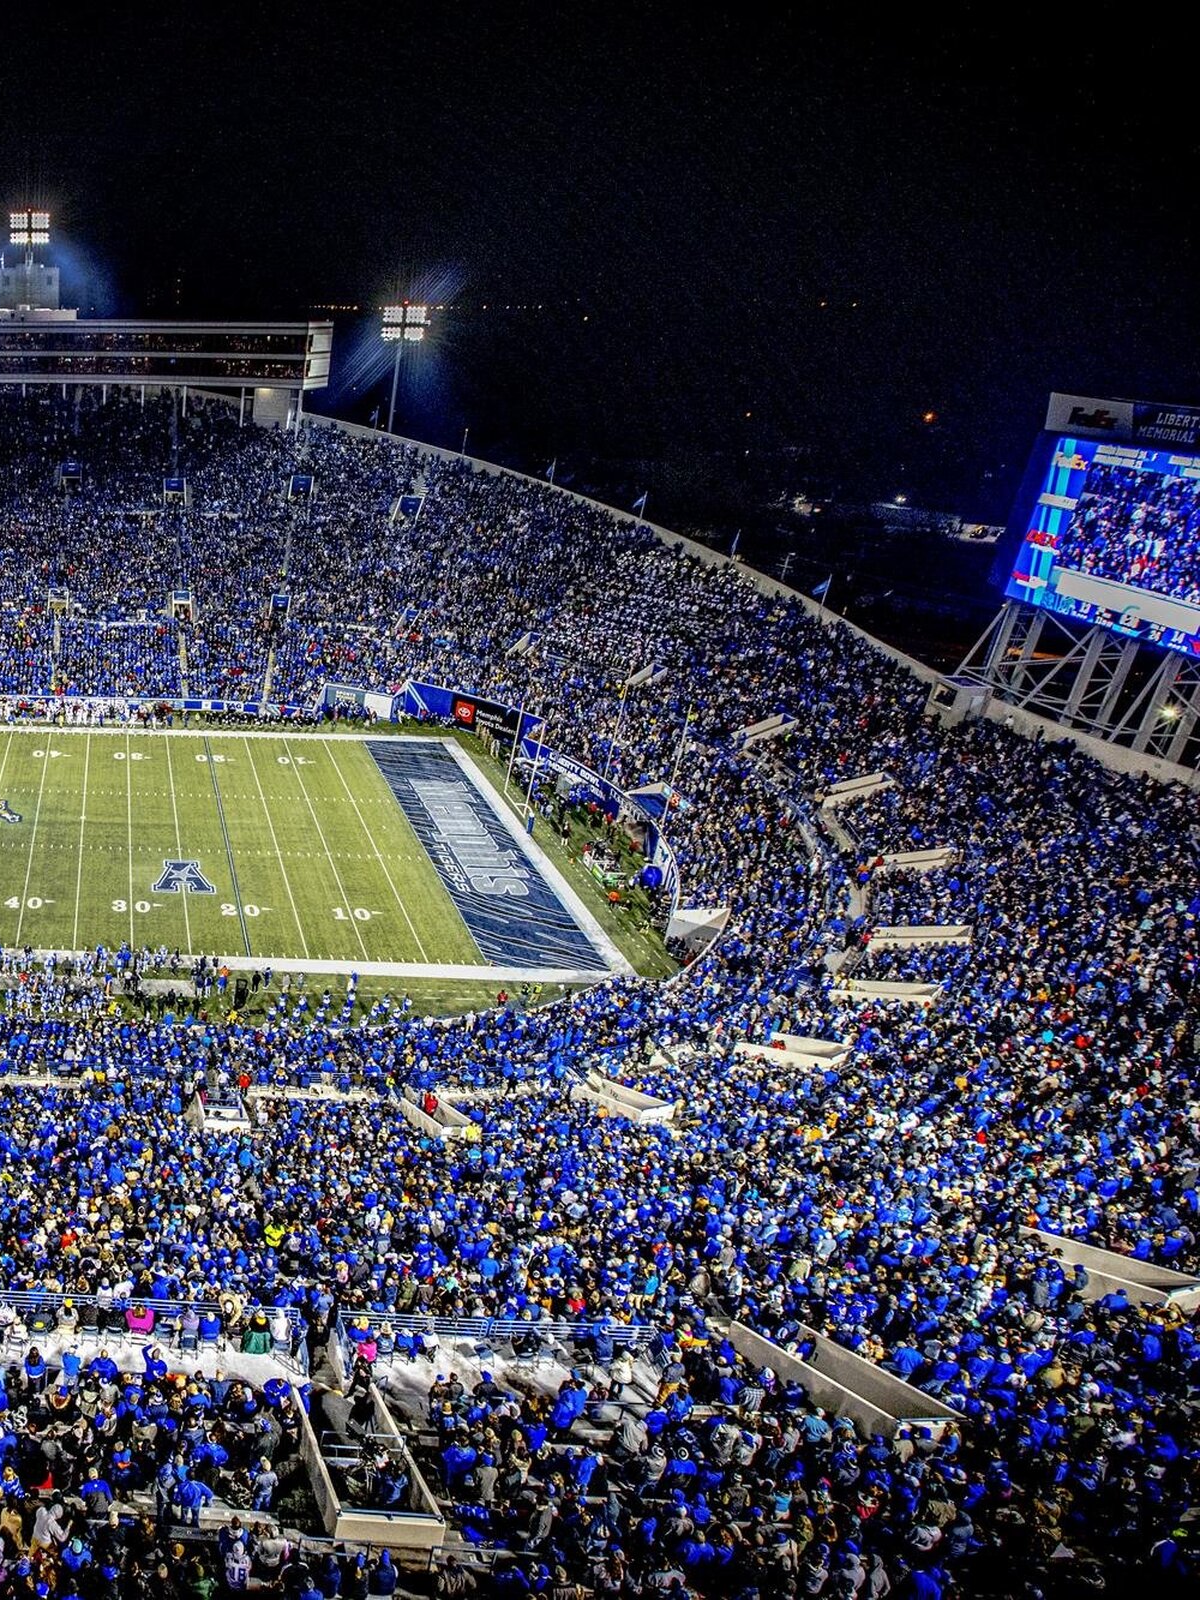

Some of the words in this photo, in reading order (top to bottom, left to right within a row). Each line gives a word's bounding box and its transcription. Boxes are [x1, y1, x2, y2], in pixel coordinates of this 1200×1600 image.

[1156, 412, 1200, 428] LIBERT
[1136, 425, 1195, 444] MEMORIAL
[475, 709, 503, 723] Memphis
[495, 723, 517, 735] Dealers
[580, 769, 601, 788] BOWL
[433, 843, 471, 892] TIGERS
[4, 896, 43, 909] 40
[112, 899, 151, 913] 30
[221, 903, 261, 917] 20
[332, 907, 371, 921] 10
